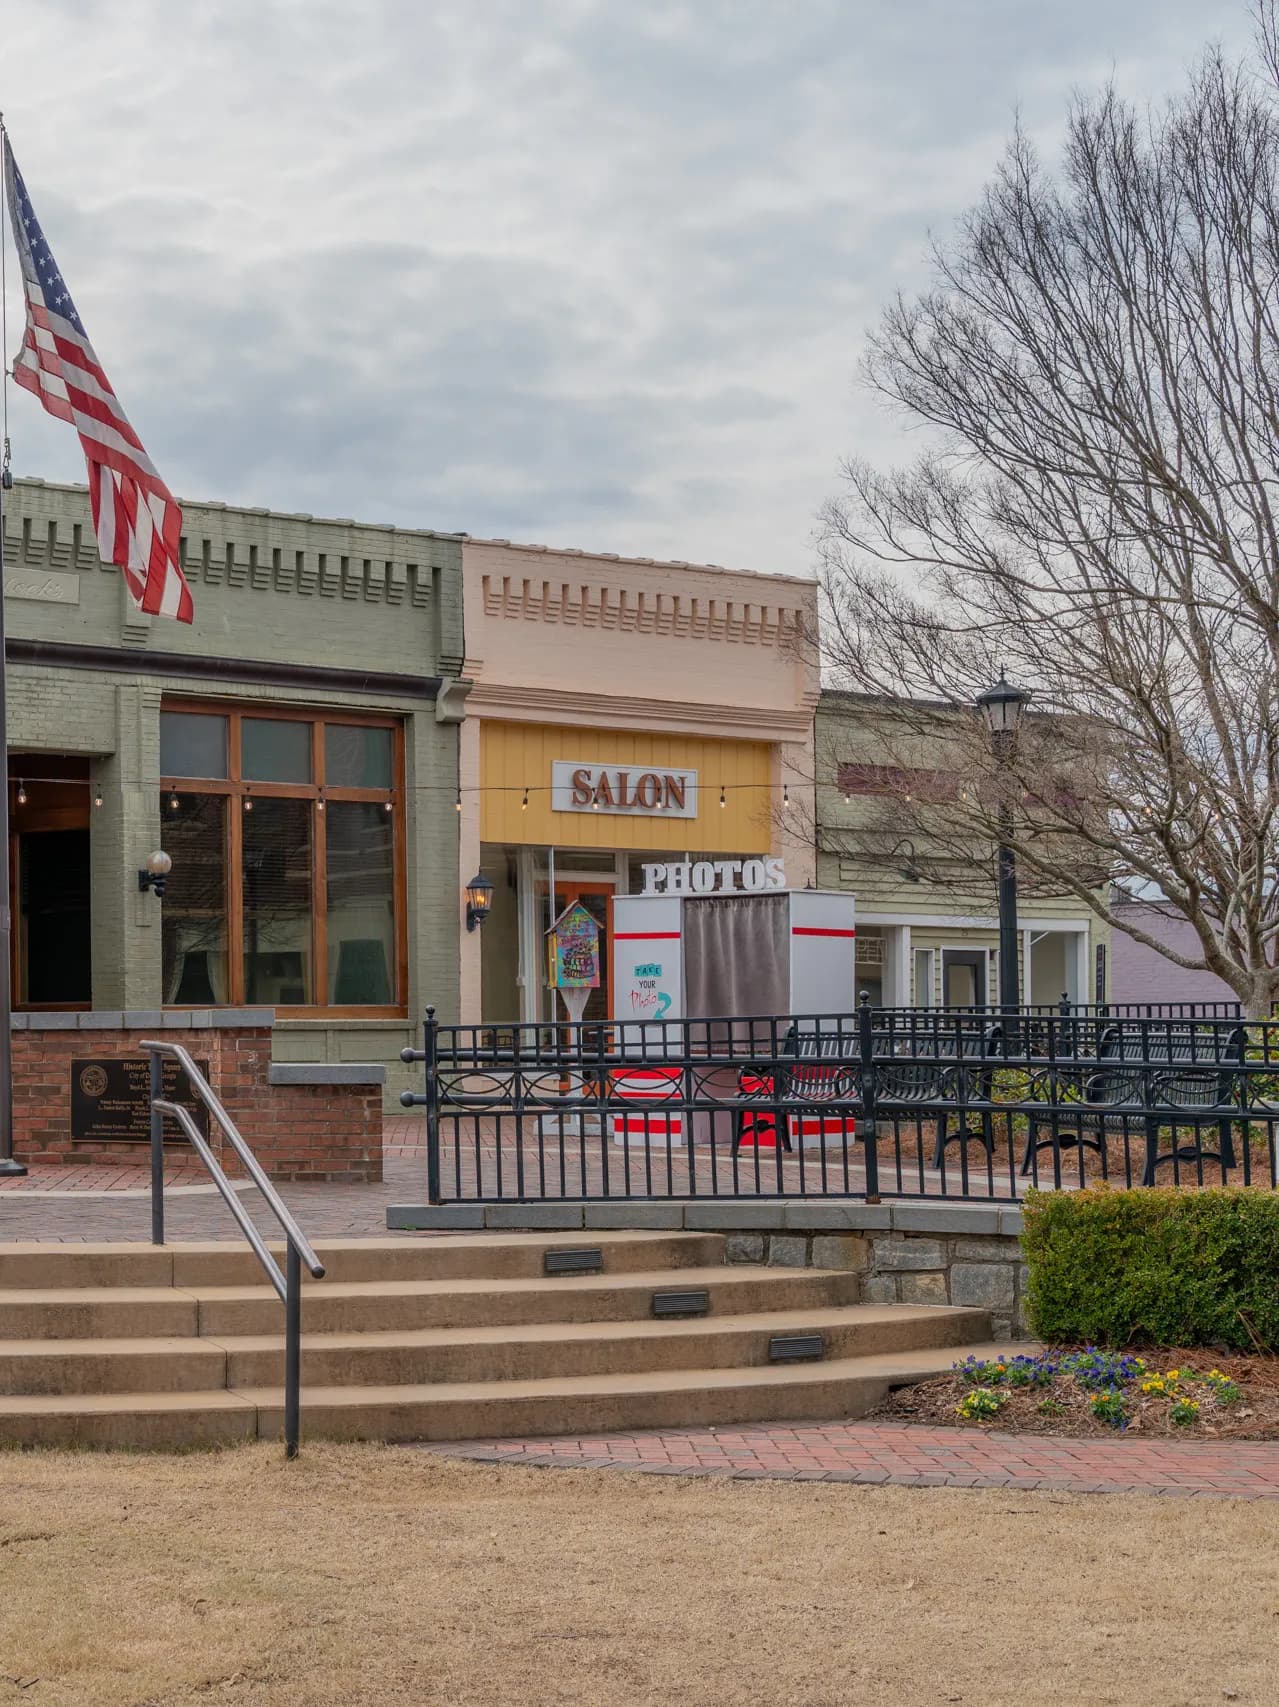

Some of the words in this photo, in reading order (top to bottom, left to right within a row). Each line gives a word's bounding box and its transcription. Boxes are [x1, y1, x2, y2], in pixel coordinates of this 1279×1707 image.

[572, 769, 688, 809] SALON
[640, 858, 787, 895] PHOTOS
[634, 966, 661, 977] TAKE
[638, 980, 656, 989] YOUR
